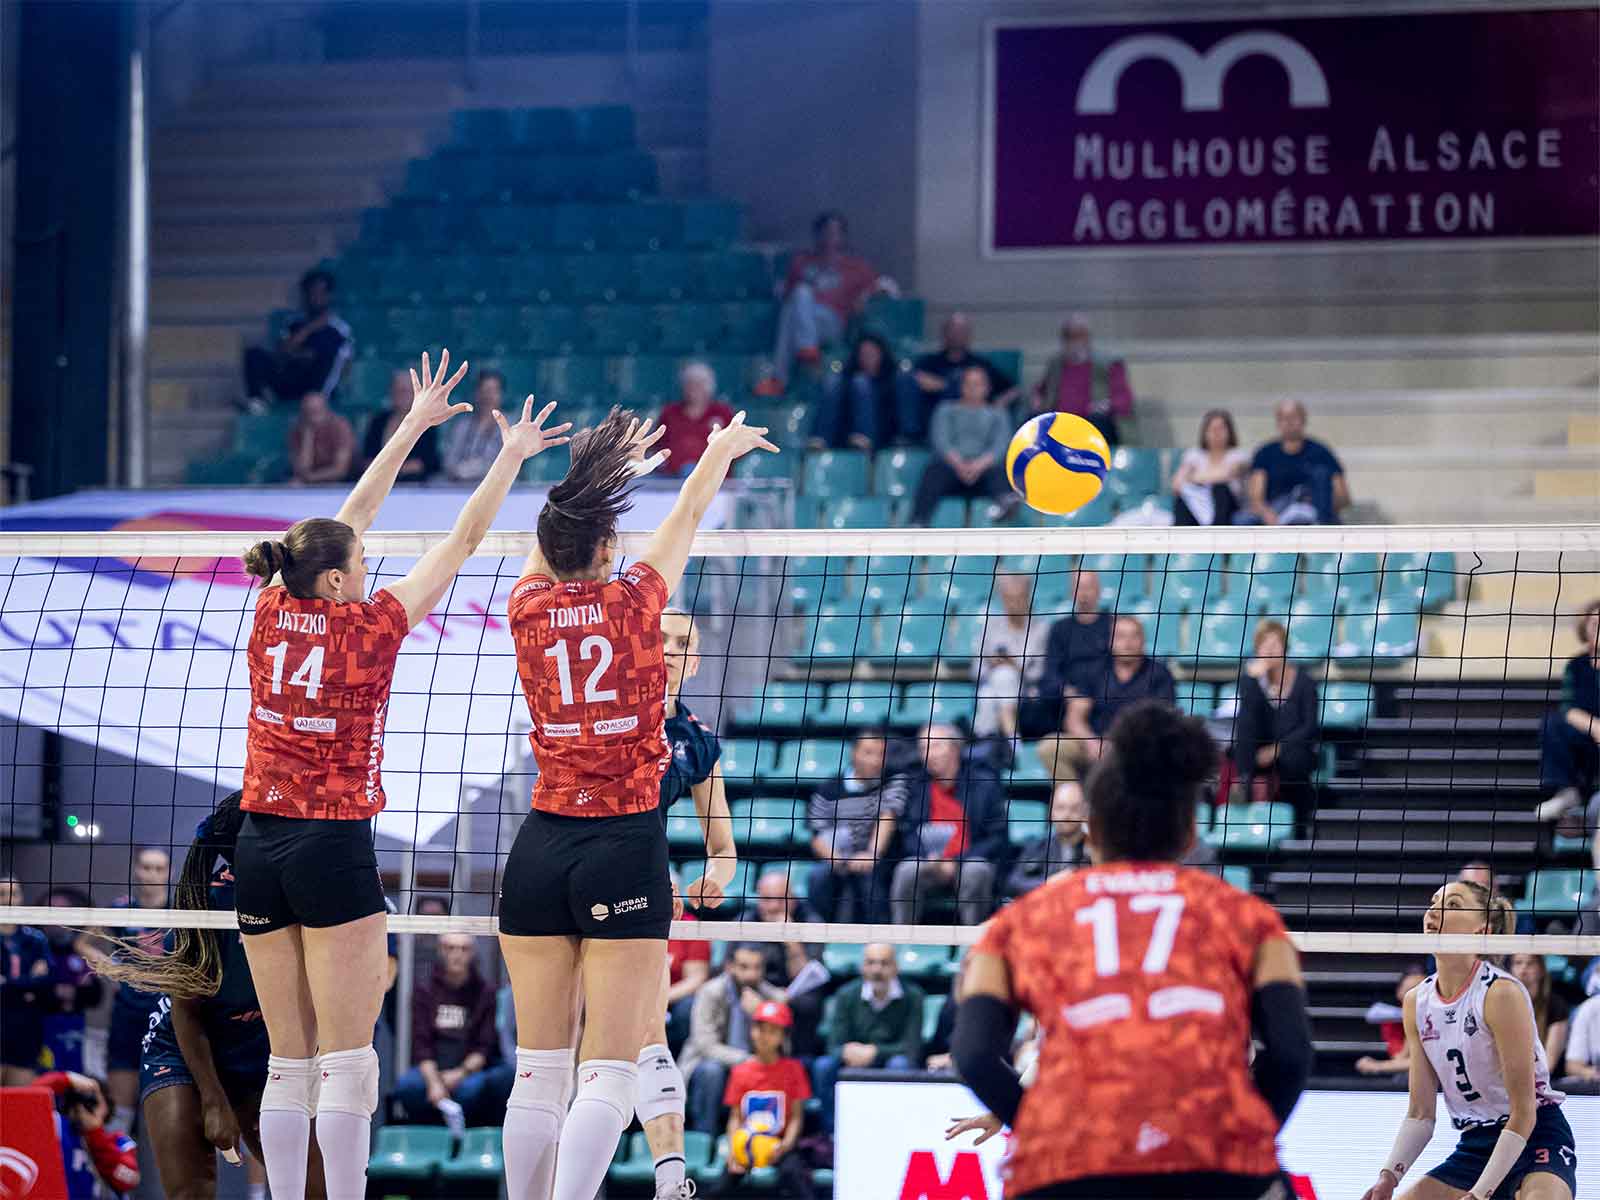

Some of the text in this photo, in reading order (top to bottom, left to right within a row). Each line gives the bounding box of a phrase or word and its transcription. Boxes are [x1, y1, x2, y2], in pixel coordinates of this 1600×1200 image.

[1074, 126, 1563, 179] MULHOUSE ALSACE
[1074, 188, 1496, 240] AGGLOMÉRATION
[275, 610, 327, 635] JATZKO
[547, 603, 604, 629] TONTAI
[265, 640, 326, 700] 14
[544, 634, 618, 706] 12
[308, 719, 334, 729] ALSACE
[610, 718, 636, 729] ALSACE
[613, 896, 648, 909] URBAN
[614, 902, 649, 915] DUMEZ
[1074, 894, 1187, 977] 17
[1446, 1048, 1473, 1092] 3
[1535, 1148, 1550, 1164] 3
